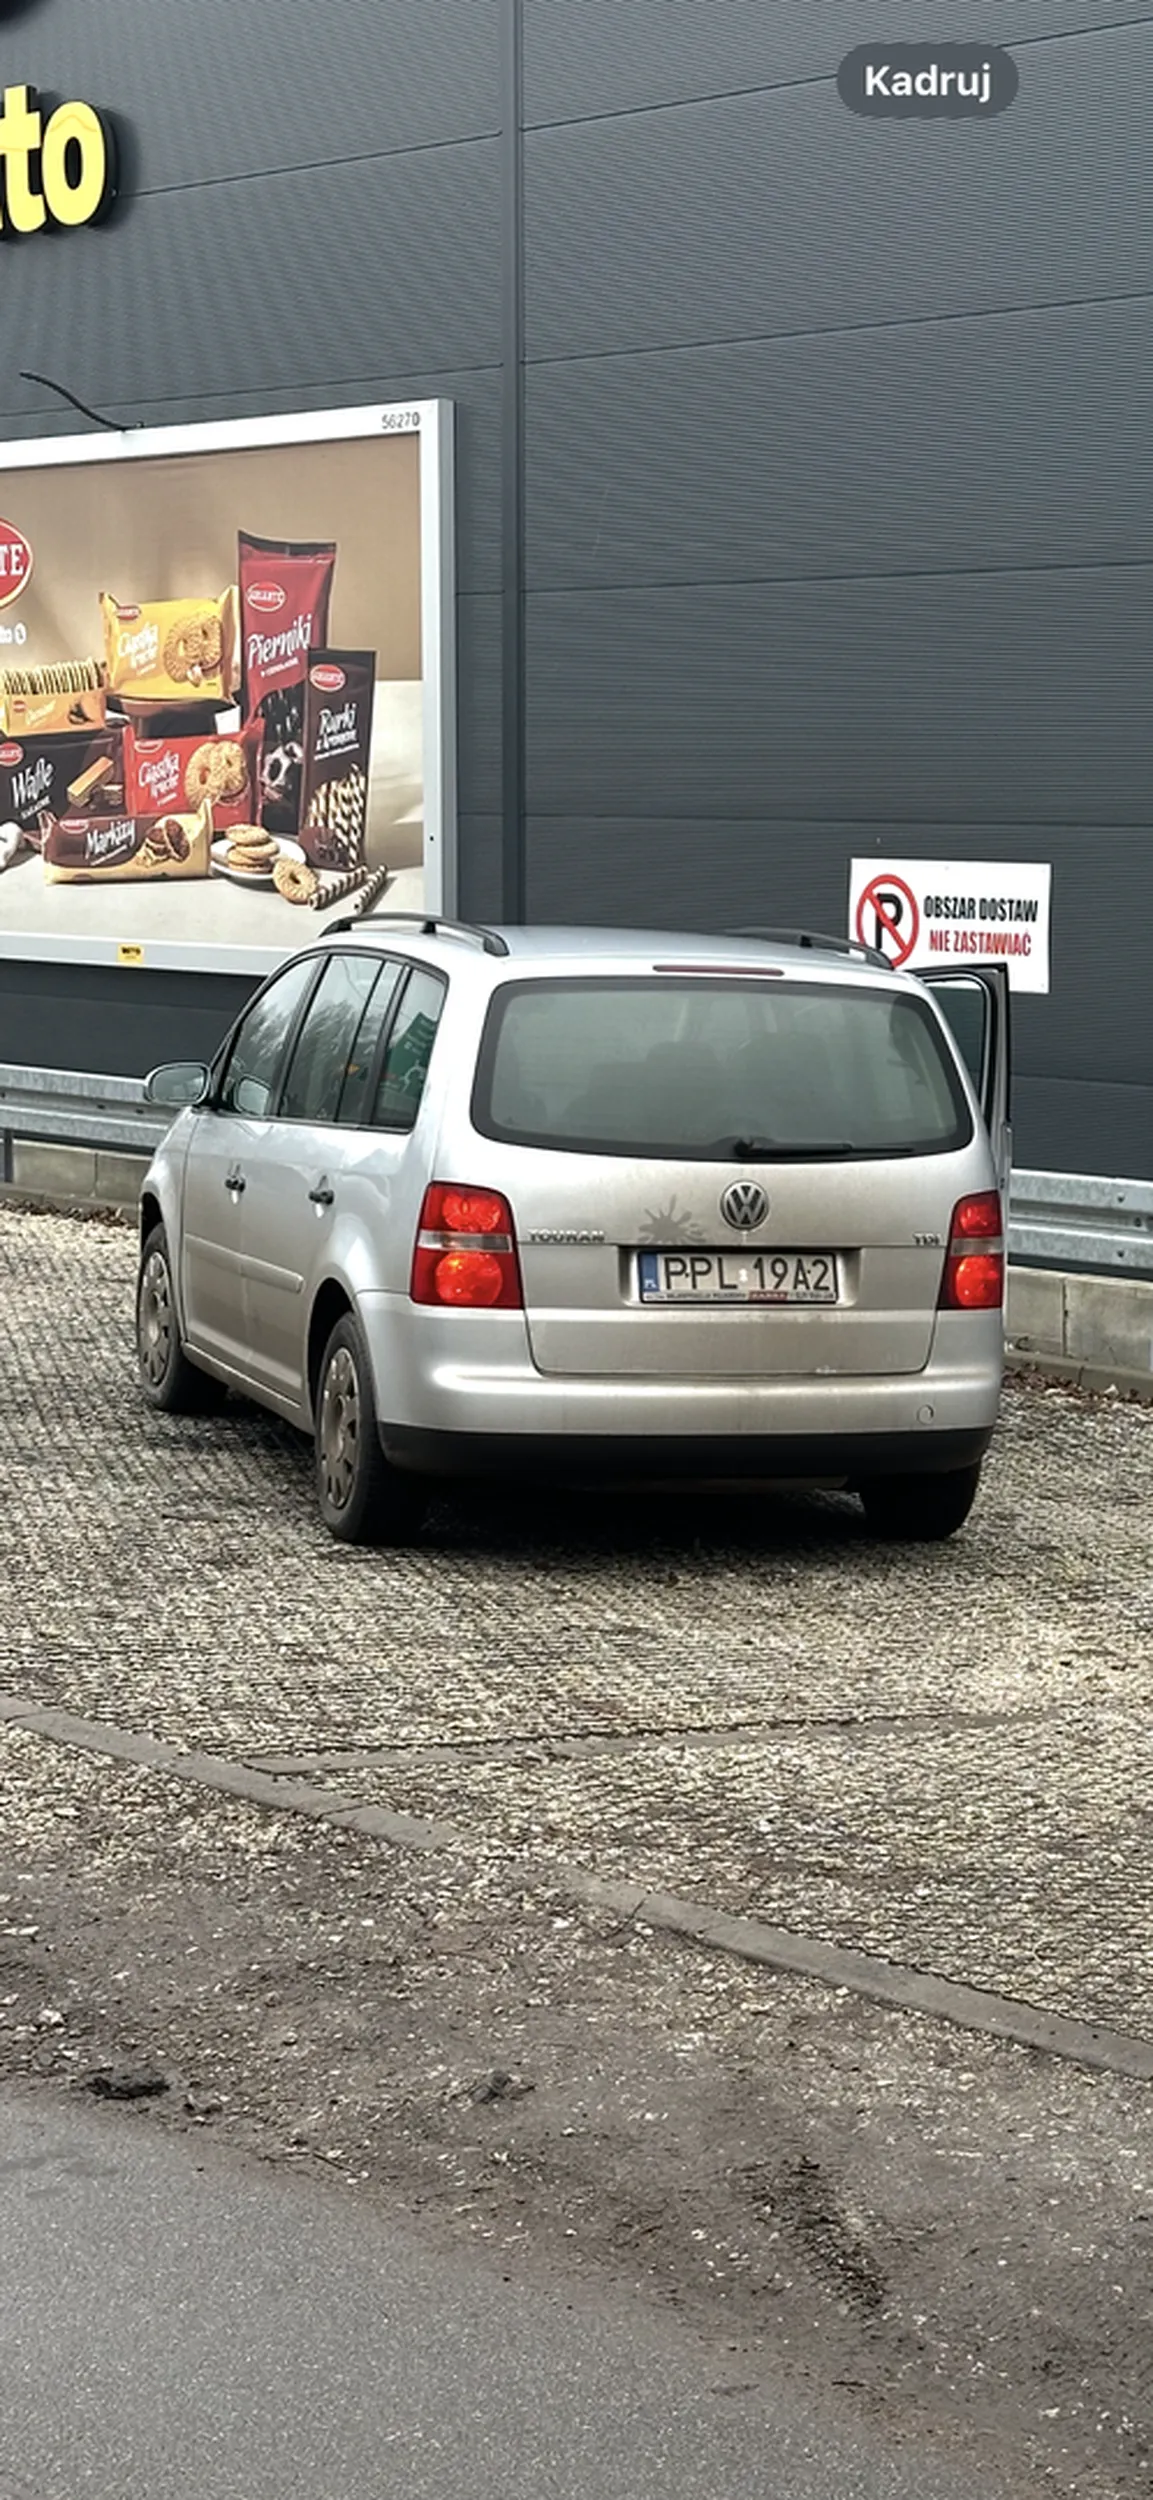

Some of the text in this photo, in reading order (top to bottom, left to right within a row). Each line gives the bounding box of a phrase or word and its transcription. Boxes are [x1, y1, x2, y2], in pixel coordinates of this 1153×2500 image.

[0, 84, 105, 232] to
[247, 613, 312, 670] Pierniki
[319, 703, 357, 735] Rurki
[11, 757, 54, 808] Wafle
[85, 819, 136, 860] Markizy
[923, 895, 1039, 922] OBSZAR DOSTAW
[929, 929, 1032, 956] NIE ZASTAWIAĆ
[527, 1229, 606, 1243] TOURAN
[912, 1232, 942, 1246] TDI
[663, 1256, 830, 1291] PPL 19A2
